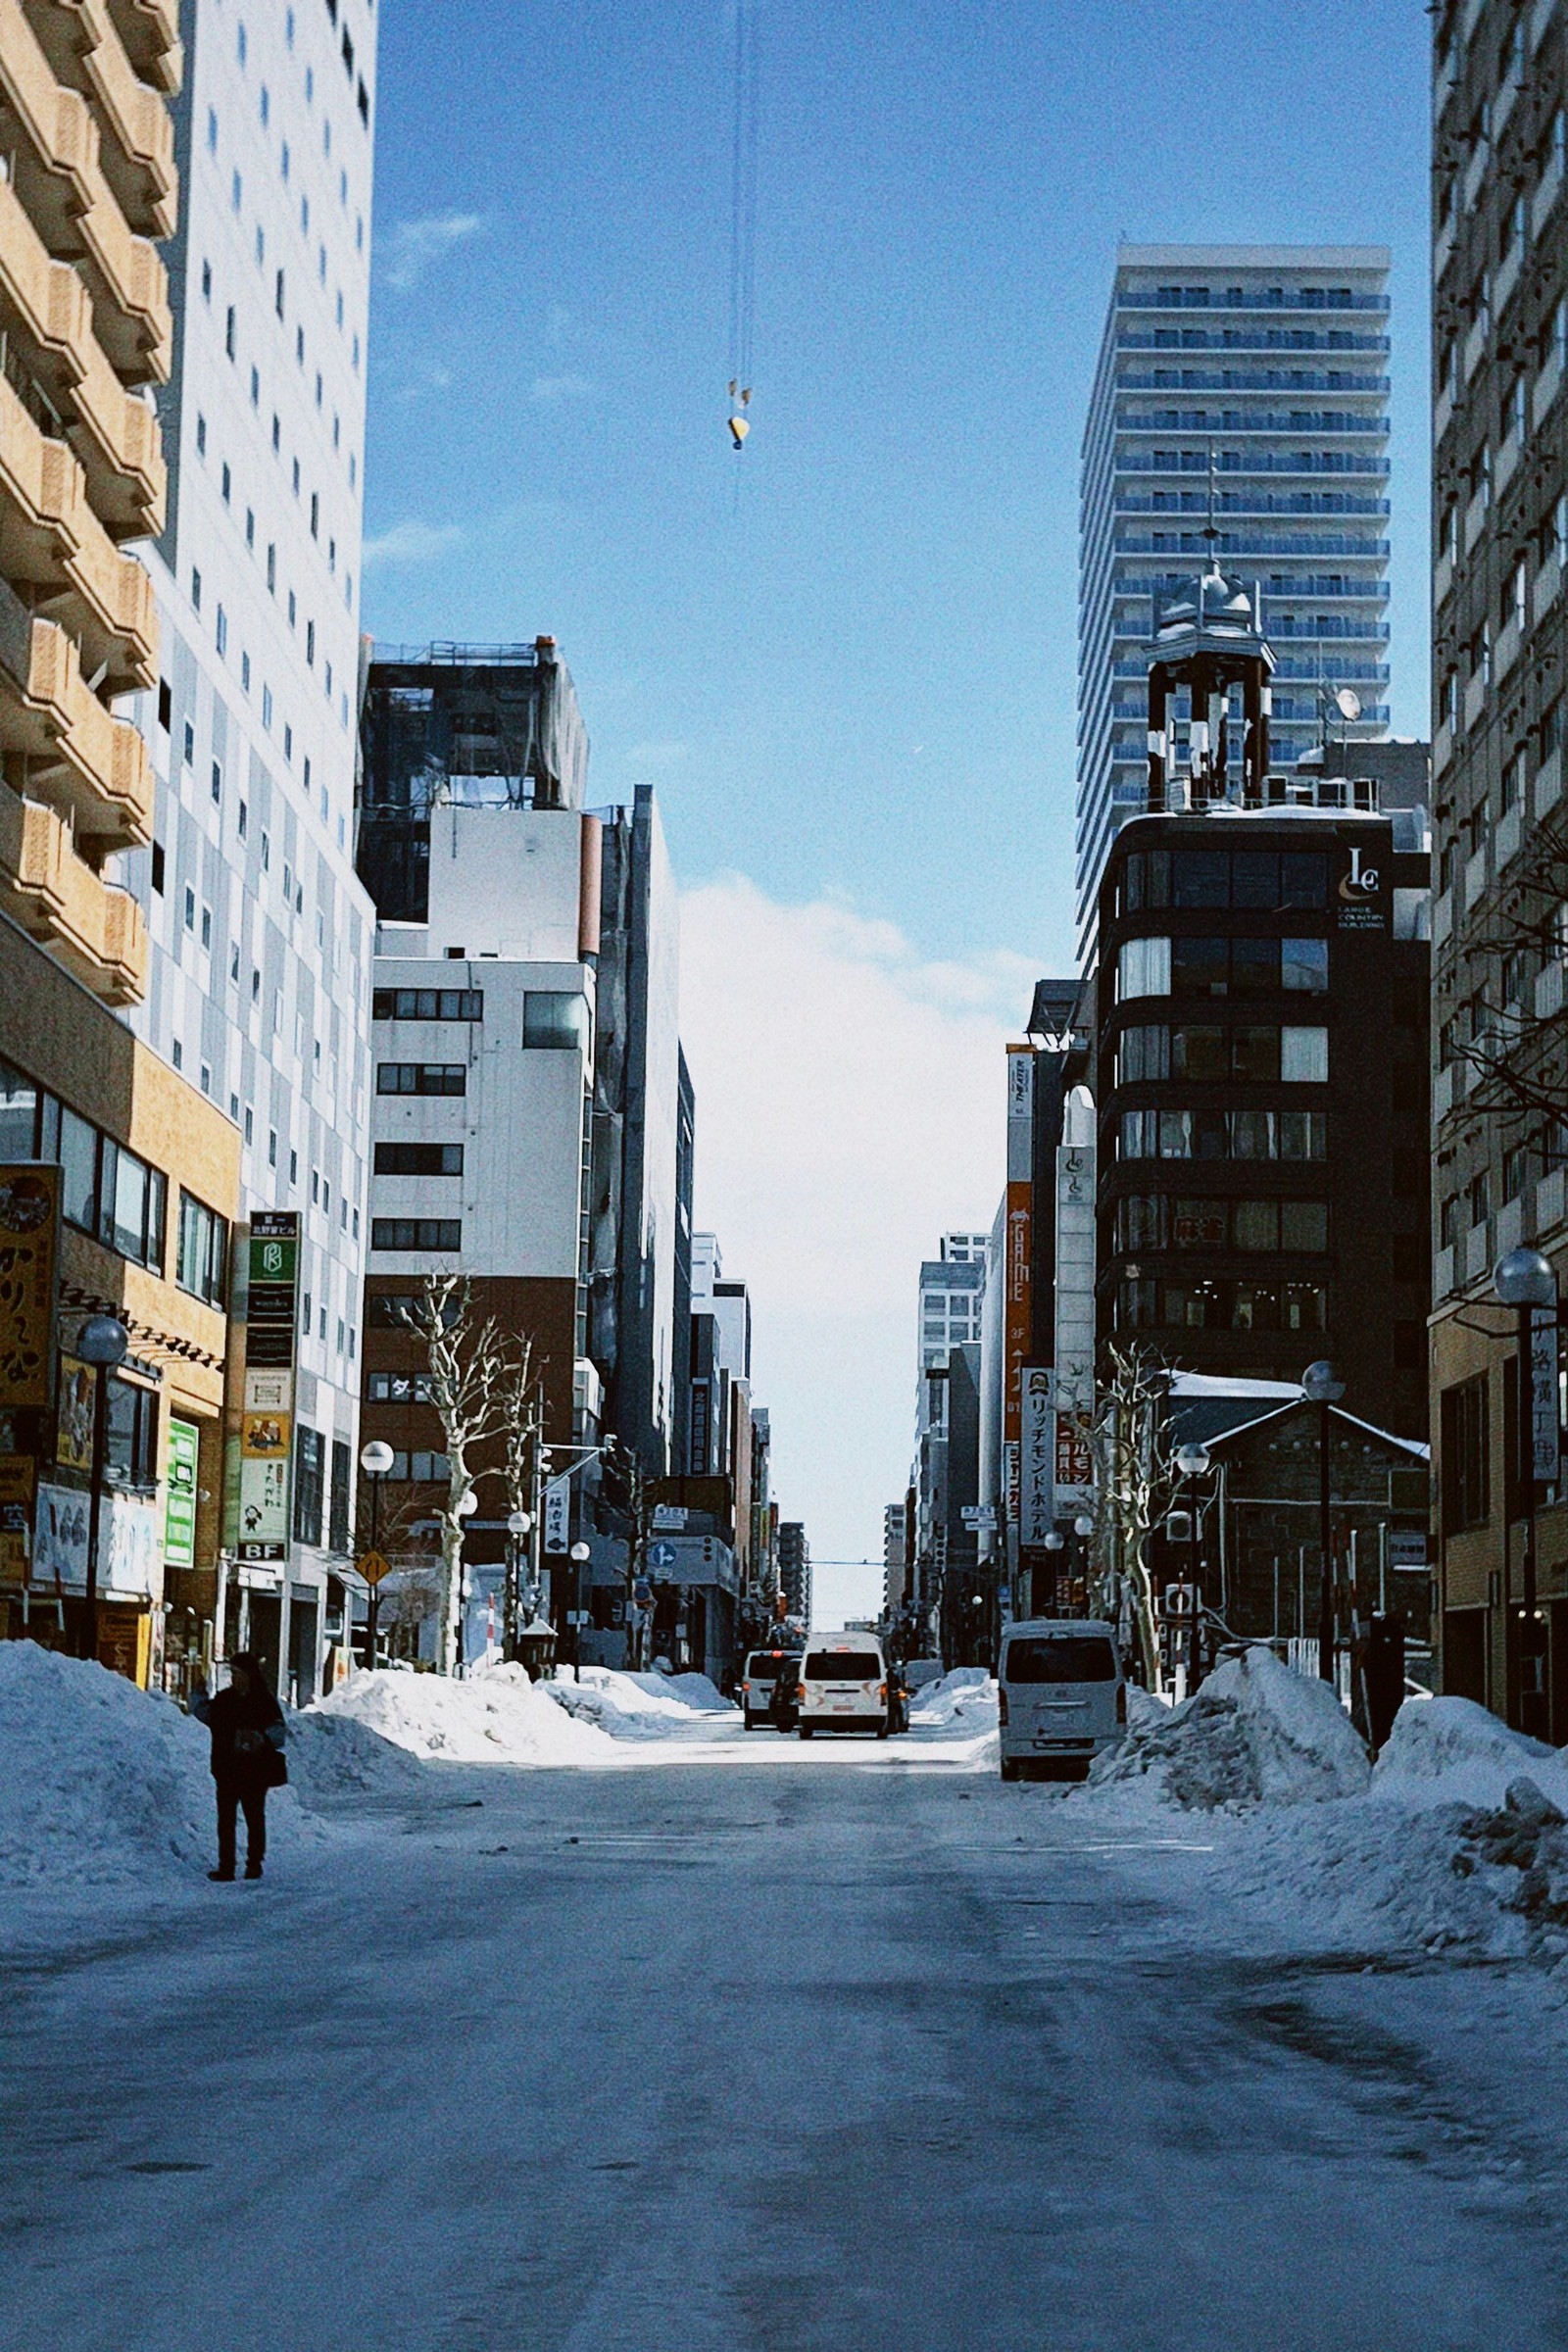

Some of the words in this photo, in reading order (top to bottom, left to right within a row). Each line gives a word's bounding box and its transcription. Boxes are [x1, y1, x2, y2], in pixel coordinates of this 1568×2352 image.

[1013, 1223, 1029, 1302] GAME
[1010, 1327, 1025, 1340] 3F
[1031, 1399, 1046, 1541] リッチモンドホテル
[245, 1544, 278, 1559] BF
